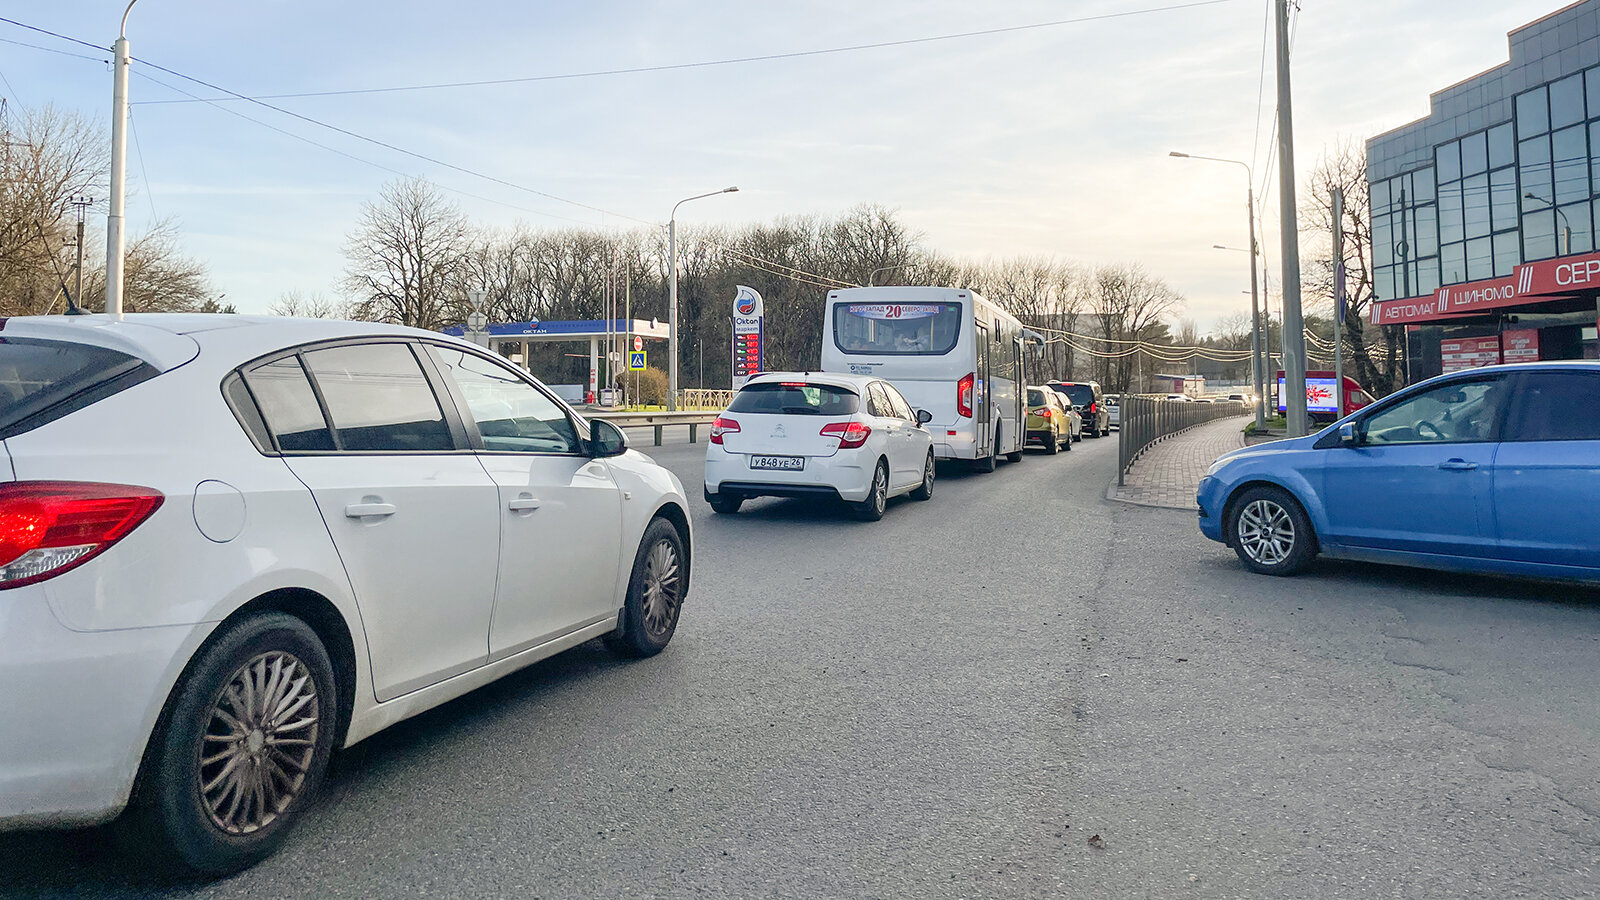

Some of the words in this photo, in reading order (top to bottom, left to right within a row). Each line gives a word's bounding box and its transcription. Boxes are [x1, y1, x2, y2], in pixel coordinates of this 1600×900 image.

[1555, 260, 1600, 285] СЕР
[1454, 285, 1514, 305] ШИНОМО
[885, 305, 902, 318] 20
[1385, 302, 1436, 319] АВТОМАГ
[791, 458, 801, 466] 26
